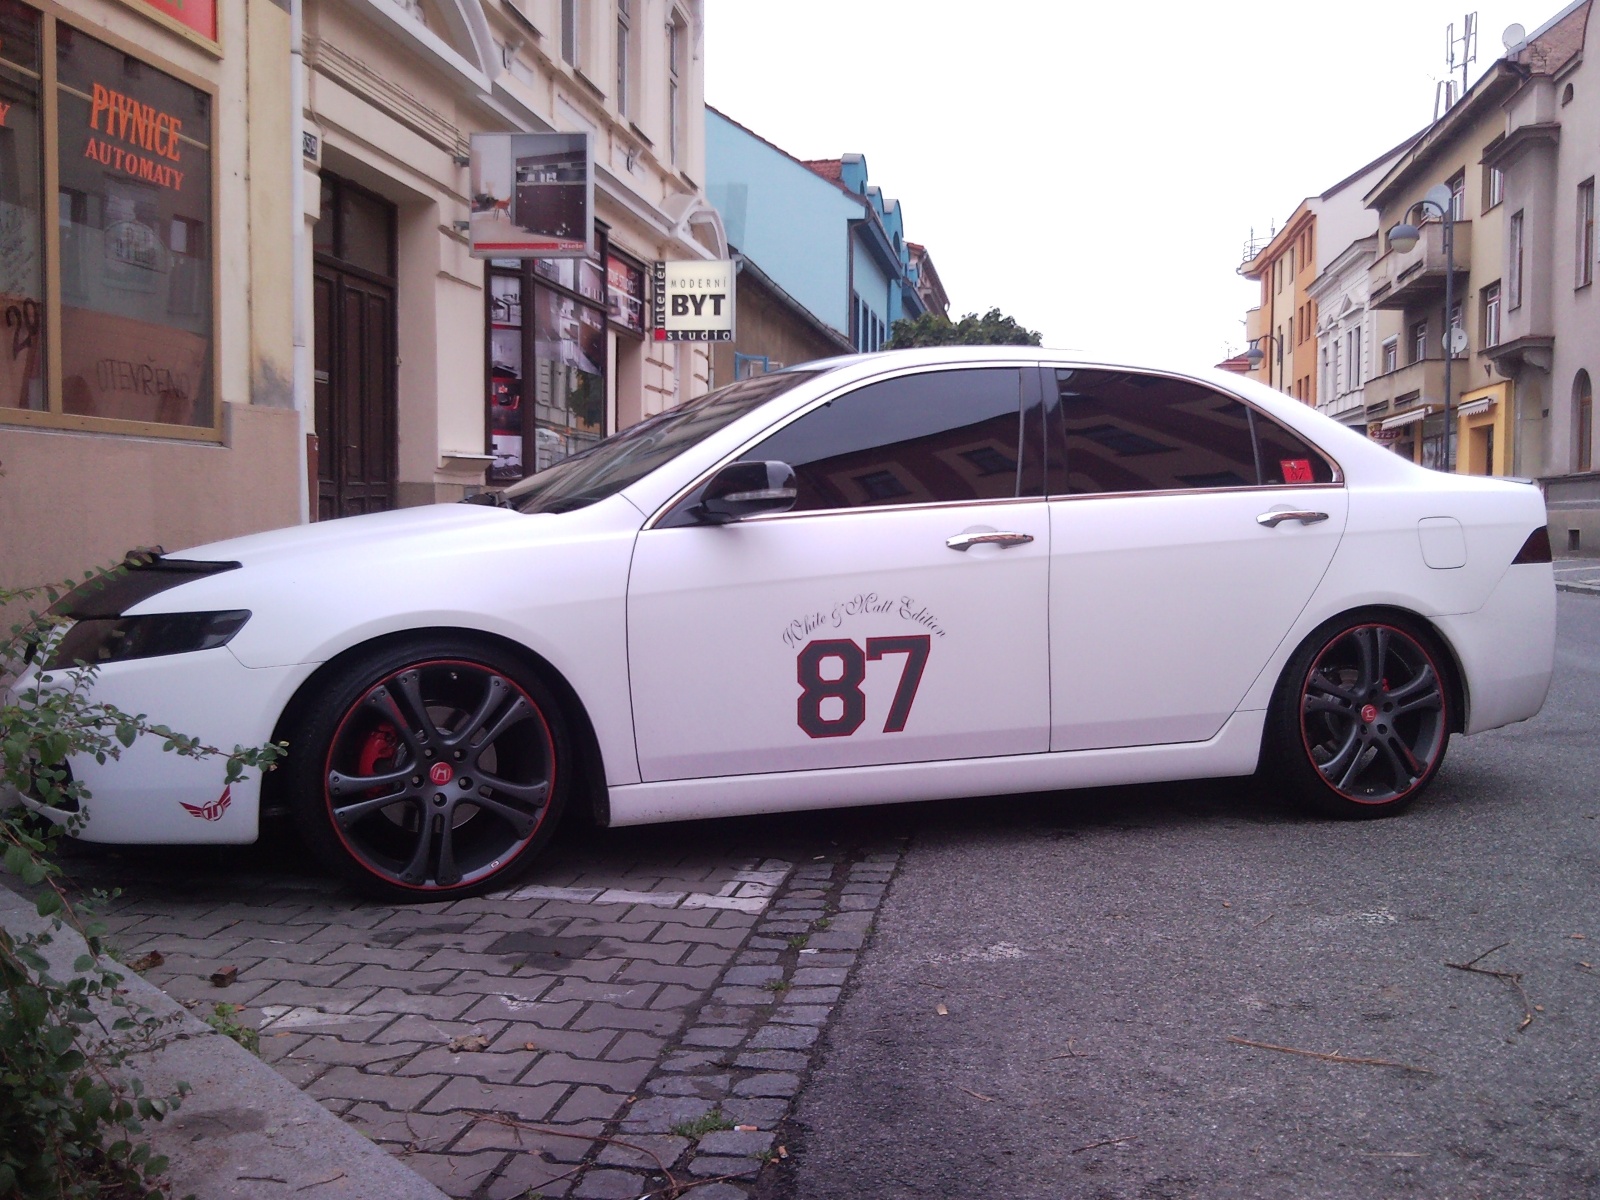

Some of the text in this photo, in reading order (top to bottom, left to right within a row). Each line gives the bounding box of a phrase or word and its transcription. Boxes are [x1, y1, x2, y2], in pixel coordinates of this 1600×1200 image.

[90, 83, 182, 162] PIVNICE
[85, 137, 184, 191] AUTOMATY
[671, 277, 727, 289] MODERNÍ
[671, 294, 726, 316] BYT
[667, 330, 730, 341] studio
[782, 611, 827, 649] White
[898, 595, 947, 638] Edition
[797, 634, 931, 739] 87
